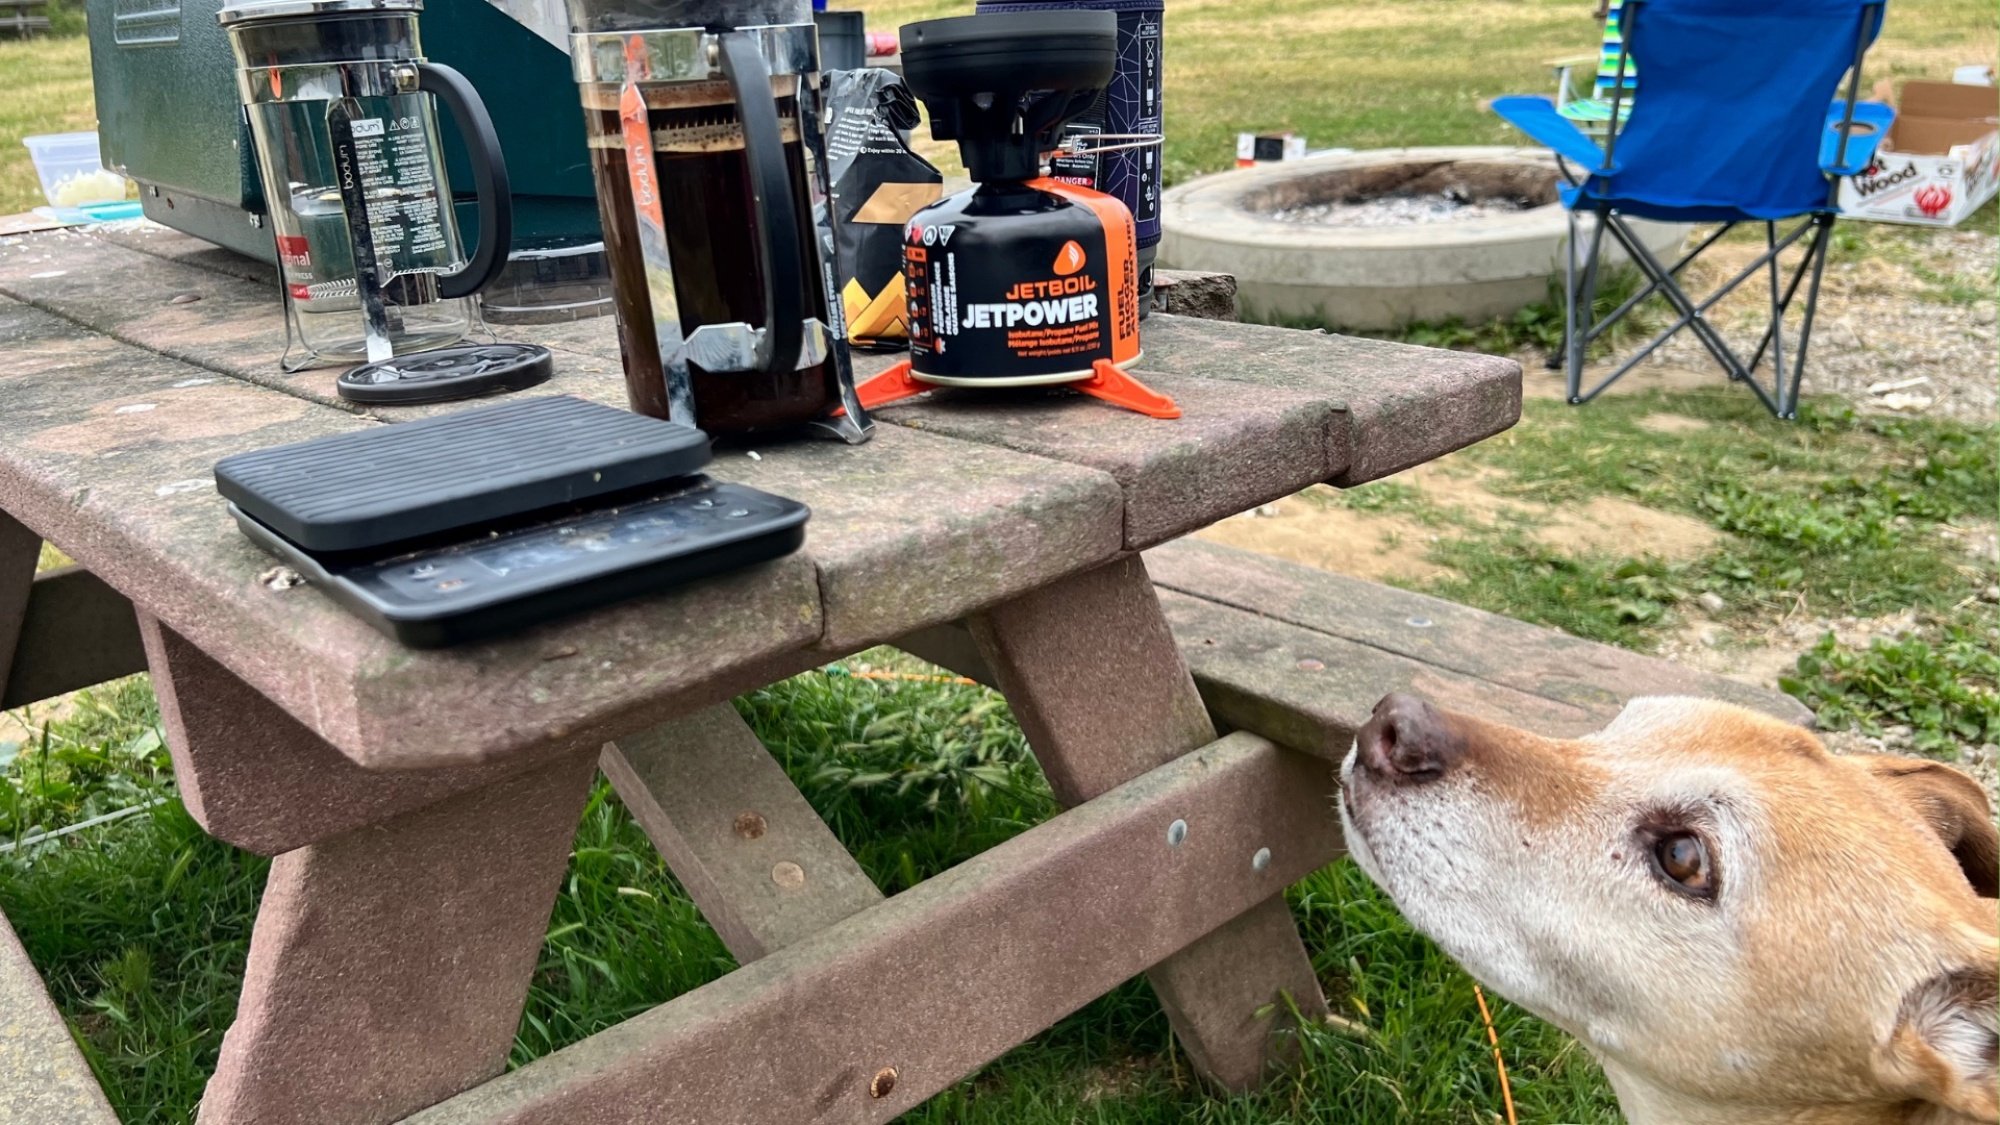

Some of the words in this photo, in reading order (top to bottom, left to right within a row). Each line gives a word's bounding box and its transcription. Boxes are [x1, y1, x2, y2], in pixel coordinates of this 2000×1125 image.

[339, 144, 354, 190] bodum
[634, 145, 653, 206] bodum
[1054, 175, 1088, 186] DANGER
[1851, 160, 1918, 197] Wood
[947, 252, 957, 294] SAISONS
[1006, 275, 1097, 300] JETBOIL
[934, 261, 945, 334] PERFORMANCE
[951, 293, 959, 336] QUATRE
[962, 293, 1099, 328] JETPOWER
[1117, 283, 1126, 341] FUEL
[1123, 259, 1131, 337] BIGGER
